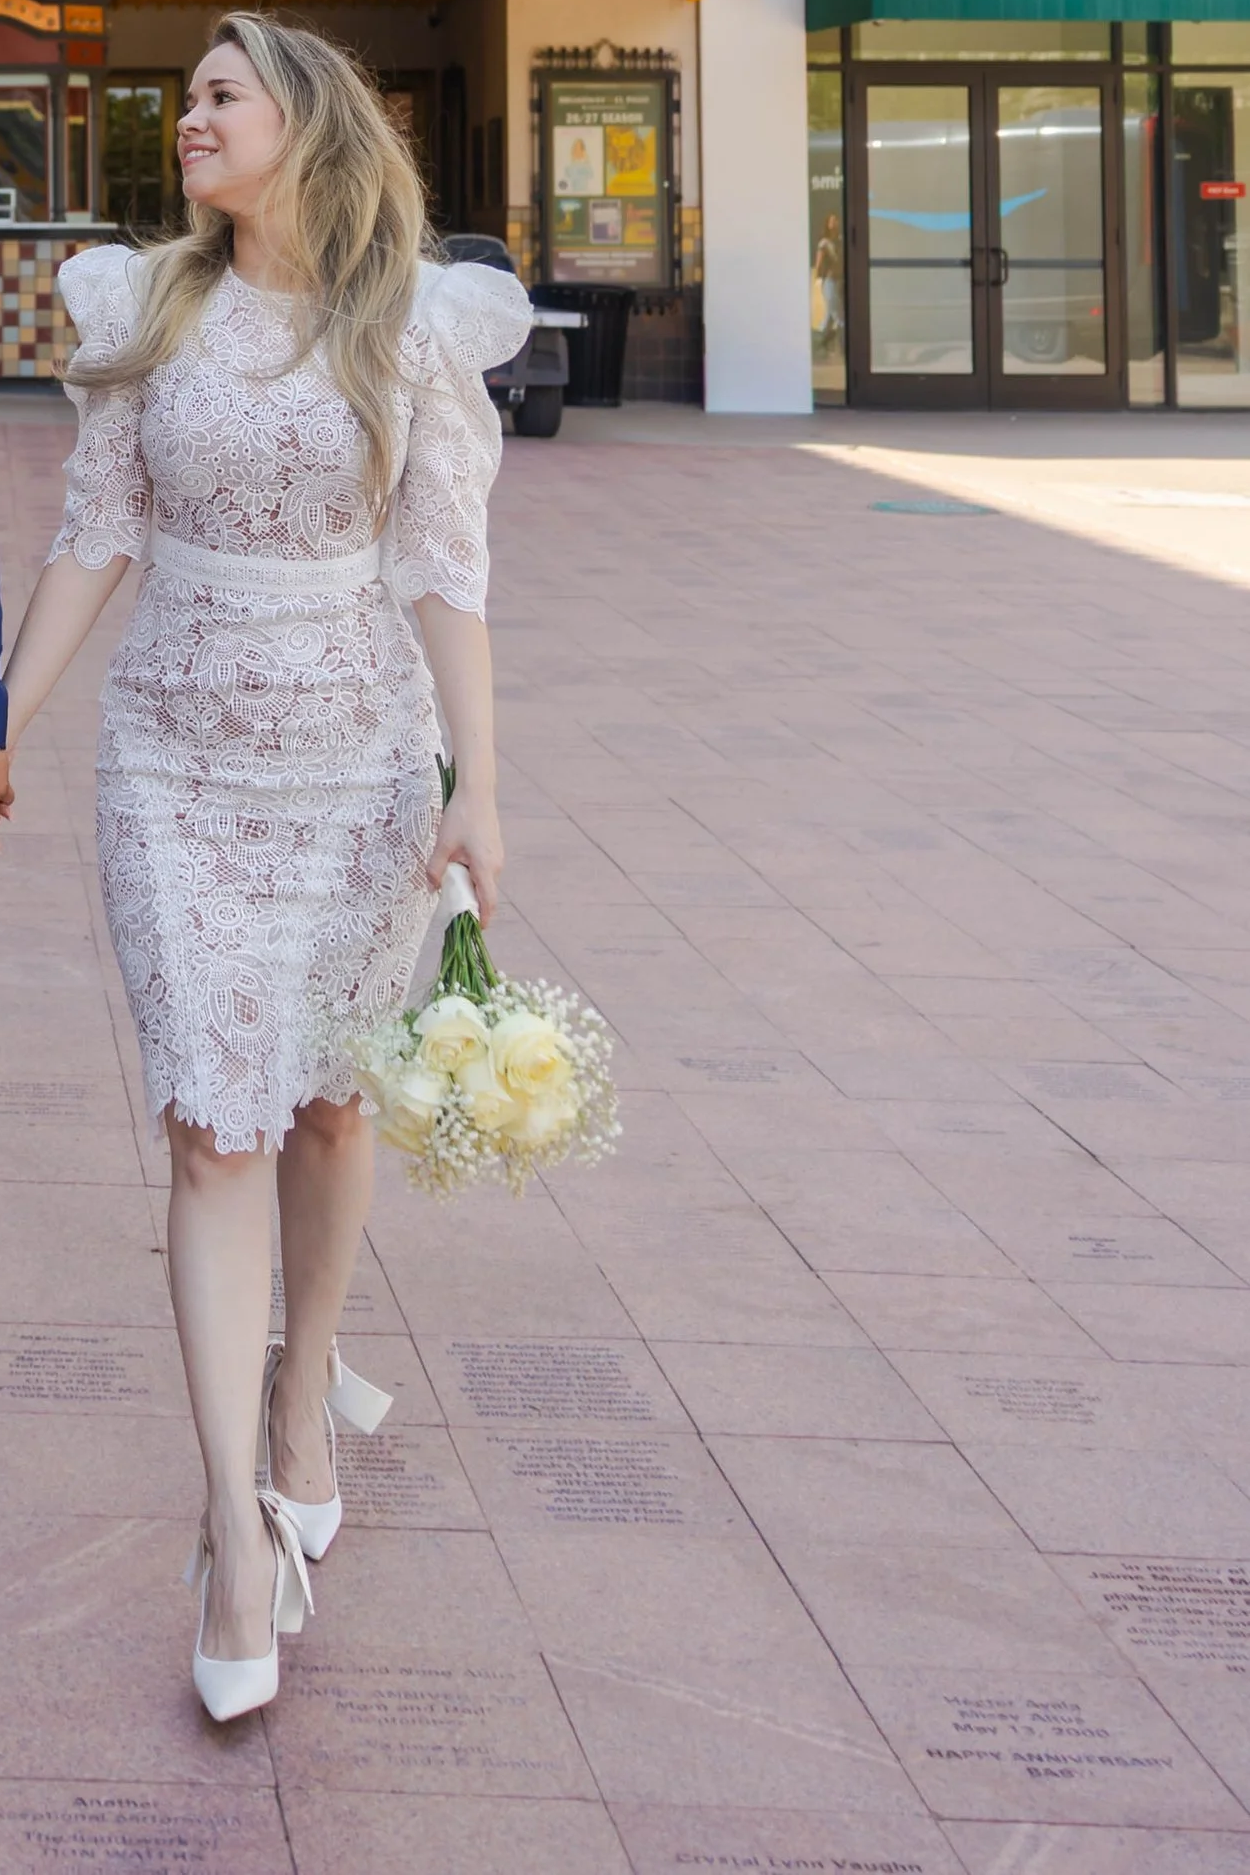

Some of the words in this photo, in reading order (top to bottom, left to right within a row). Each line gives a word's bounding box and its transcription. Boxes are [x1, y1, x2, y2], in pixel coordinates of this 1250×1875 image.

[601, 112, 644, 124] SEASON
[1151, 1573, 1224, 1585] Medina
[1026, 1698, 1082, 1711] Ayala
[952, 1721, 998, 1736] May
[1051, 1725, 1110, 1739] 2000
[925, 1747, 1001, 1761] HAPPY
[1012, 1752, 1174, 1769] ANNIVERSARY
[73, 1796, 159, 1808] Another
[674, 1851, 761, 1868] Crystal
[768, 1855, 826, 1870] Lynn
[830, 1857, 924, 1874] Vaughn
